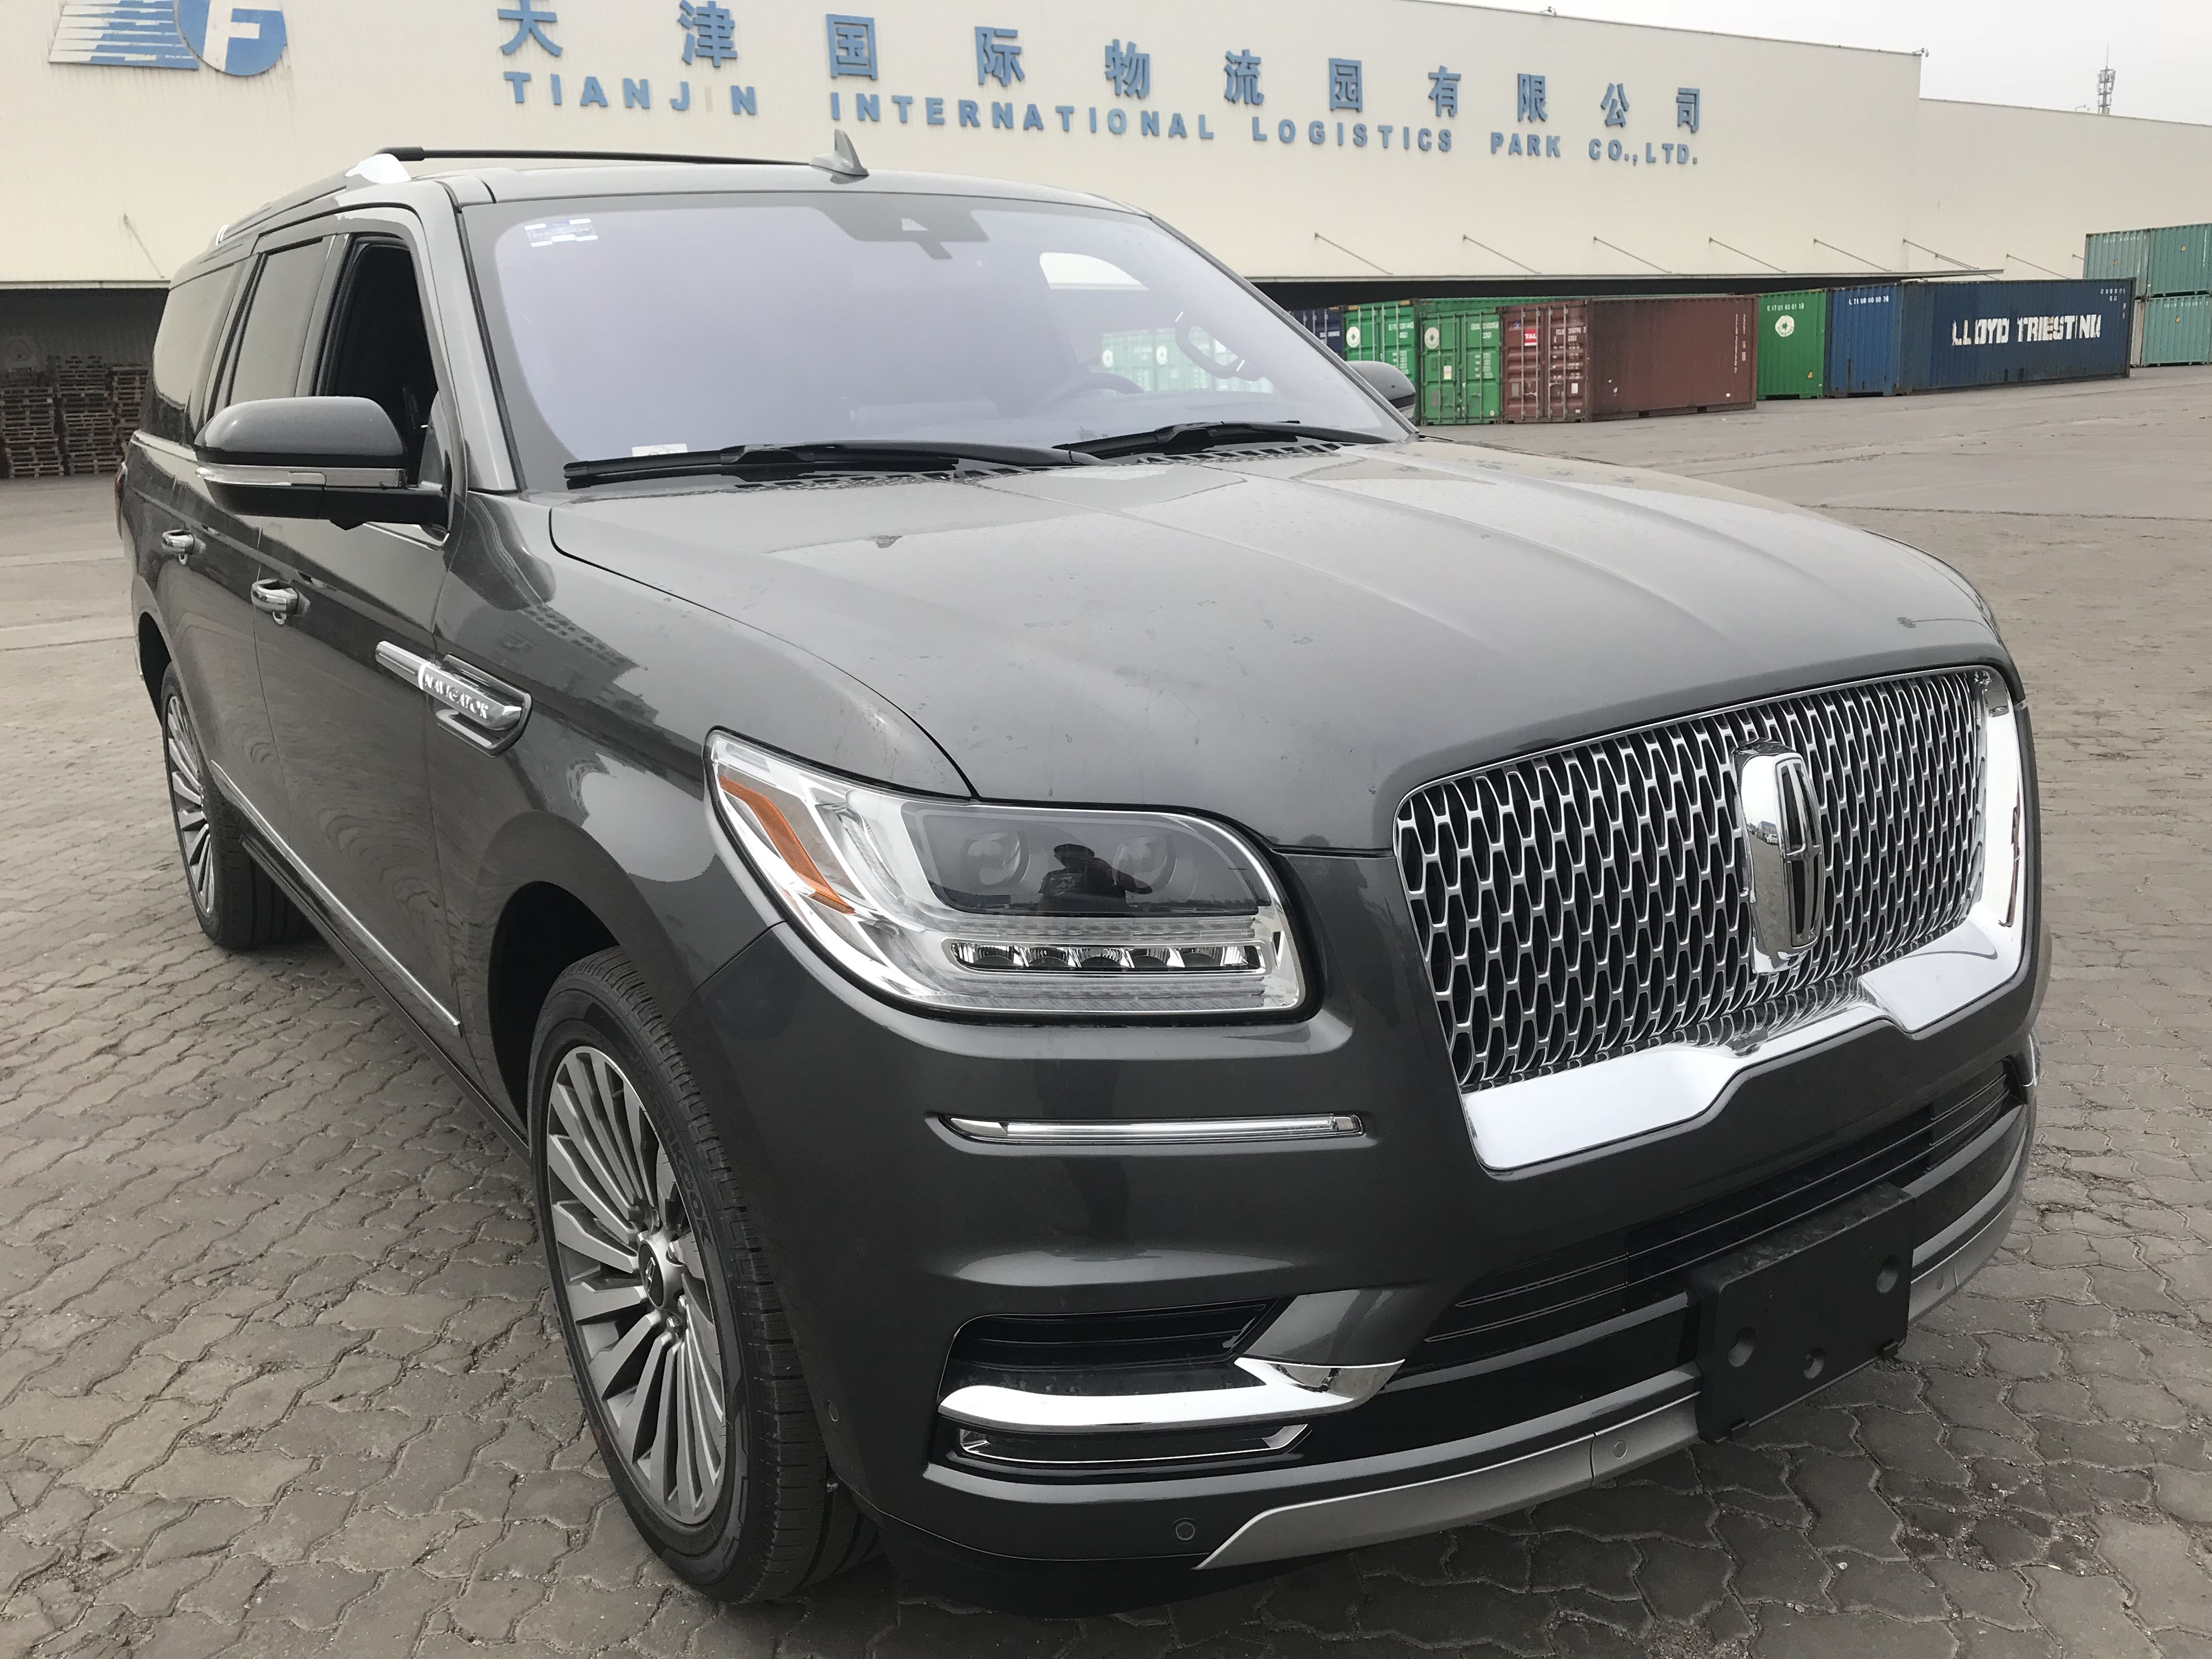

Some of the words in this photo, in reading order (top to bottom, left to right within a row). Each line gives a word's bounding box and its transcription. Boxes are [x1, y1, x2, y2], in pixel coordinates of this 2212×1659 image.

[830, 92, 1214, 139] INTERNATIONAL
[1252, 116, 1452, 153] LOGISTICS
[1491, 132, 1561, 157] PARK
[1952, 318, 2010, 346] LLOYD
[424, 674, 489, 719] NAVIGATOR
